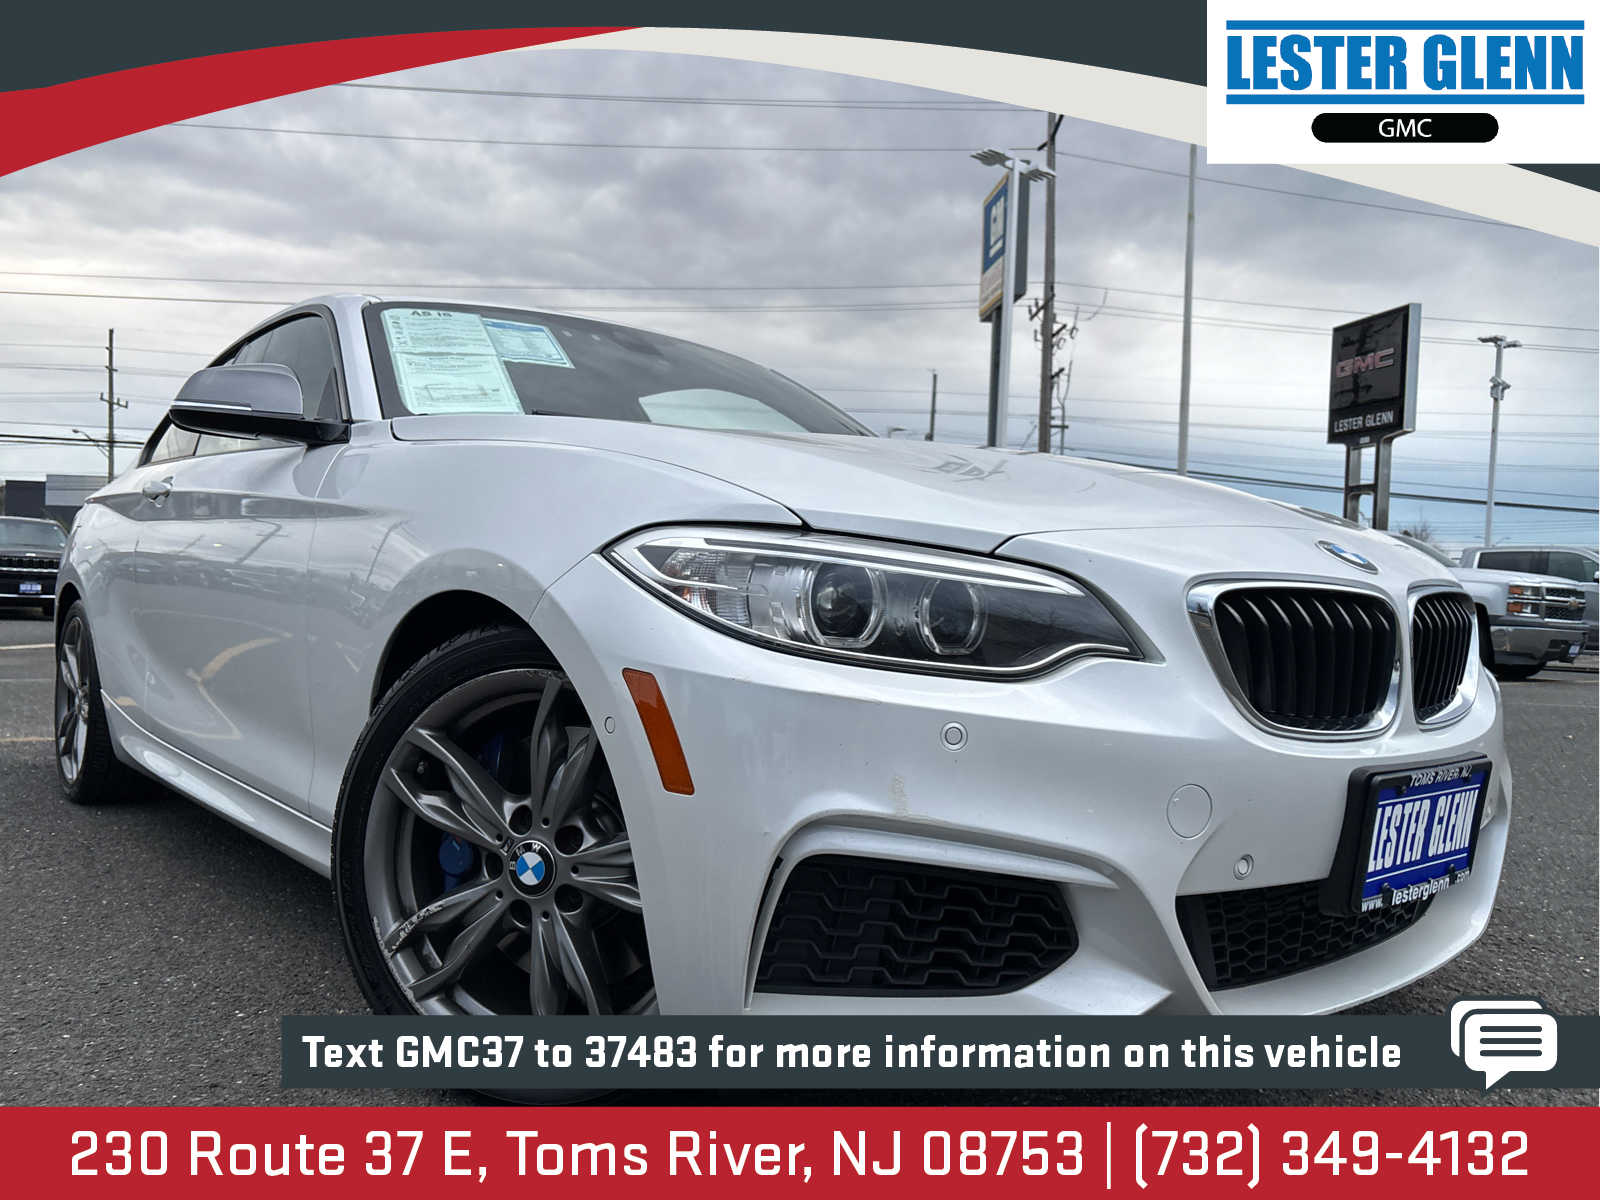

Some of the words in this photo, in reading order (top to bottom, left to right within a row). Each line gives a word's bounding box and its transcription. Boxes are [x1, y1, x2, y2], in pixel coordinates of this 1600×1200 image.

[1335, 348, 1395, 378] GMC
[1334, 416, 1363, 433] LESTER
[1365, 410, 1394, 428] GLENN
[1410, 772, 1436, 788] TOMS
[1368, 798, 1431, 873] LESTER
[1428, 789, 1479, 857] GLENN
[1361, 898, 1384, 913] www.
[1391, 877, 1450, 906] lesterglenn
